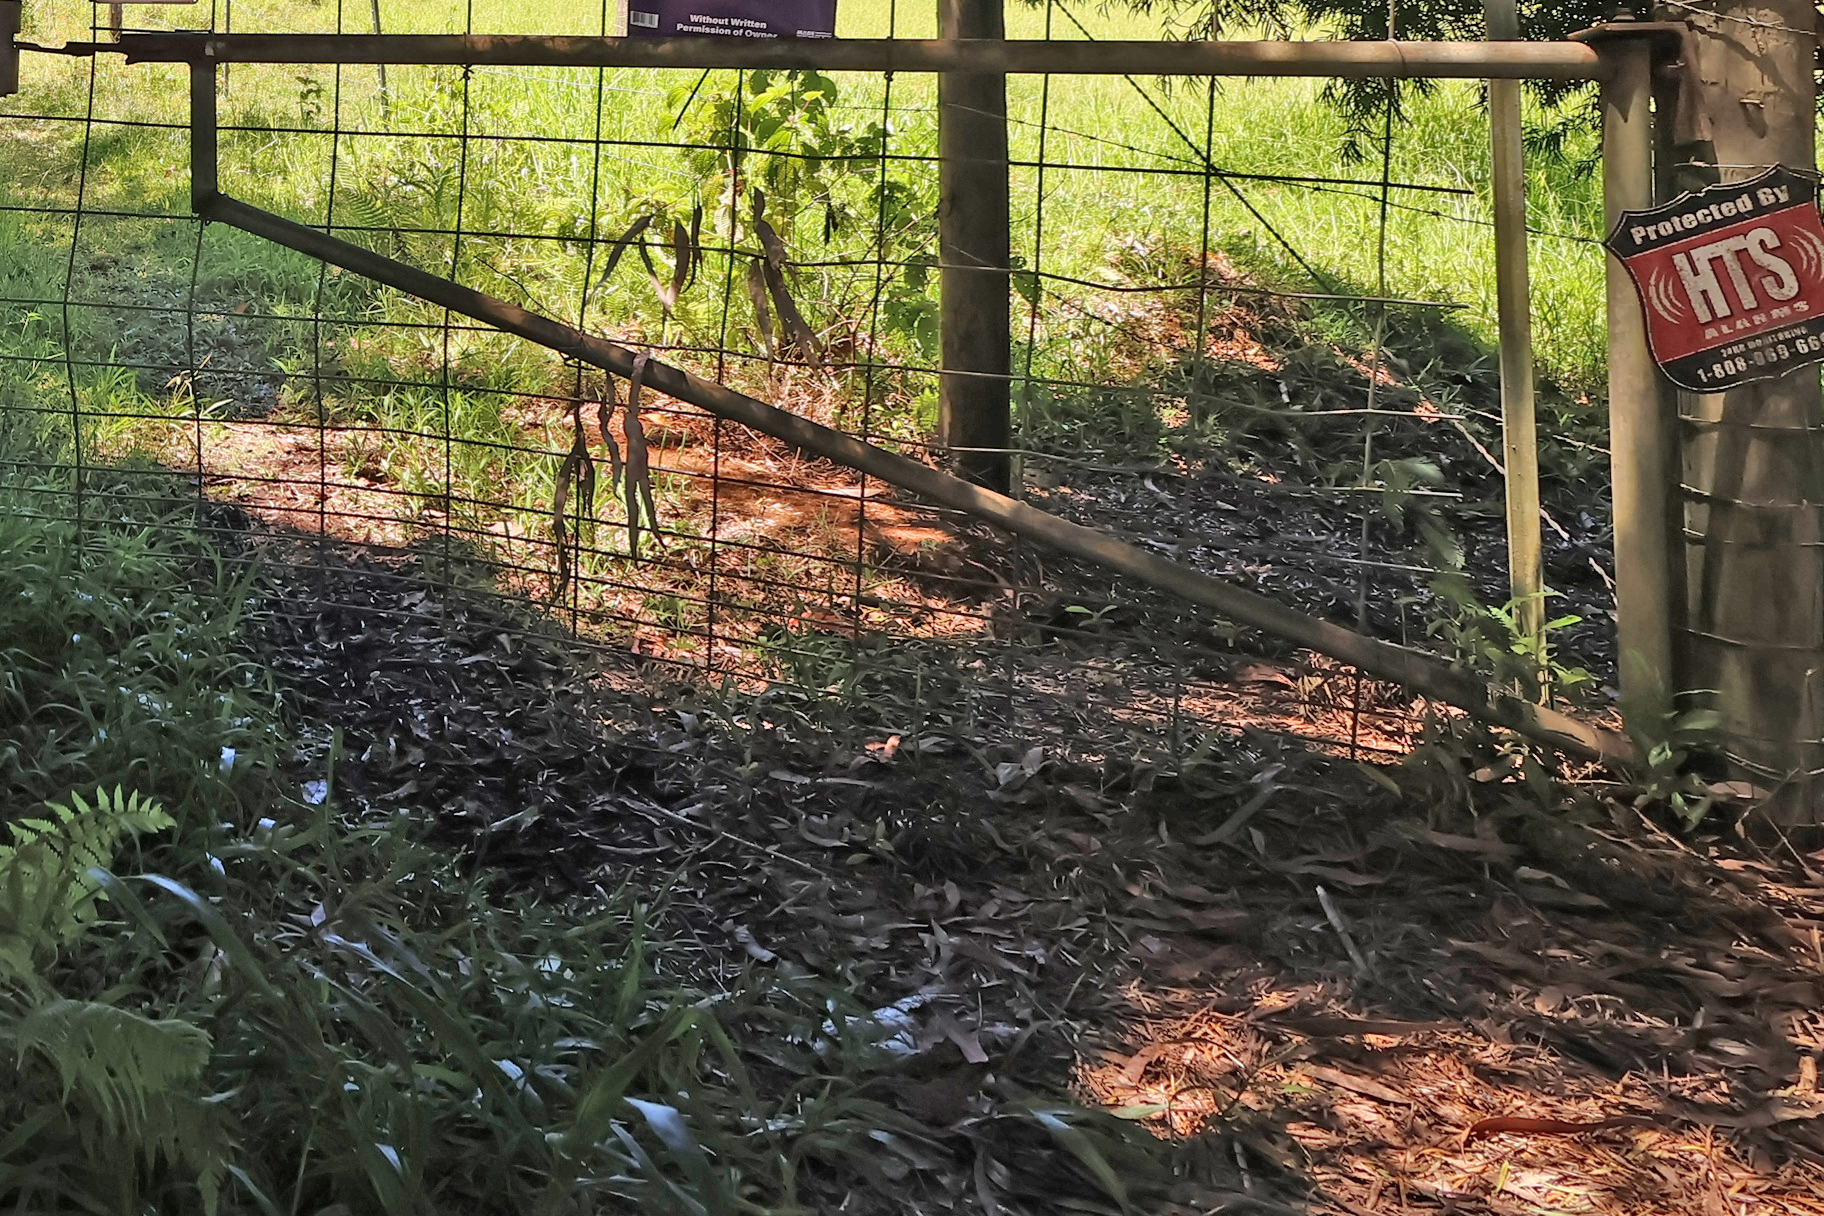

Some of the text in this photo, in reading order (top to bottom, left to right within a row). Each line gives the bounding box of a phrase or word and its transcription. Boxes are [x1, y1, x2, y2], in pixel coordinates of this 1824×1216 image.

[676, 23, 731, 35] Permission
[732, 29, 744, 37] of
[689, 14, 767, 29] Without Written
[1630, 184, 1790, 246] Protected By
[1672, 227, 1800, 324] HTS
[1704, 300, 1810, 340] ALARMS
